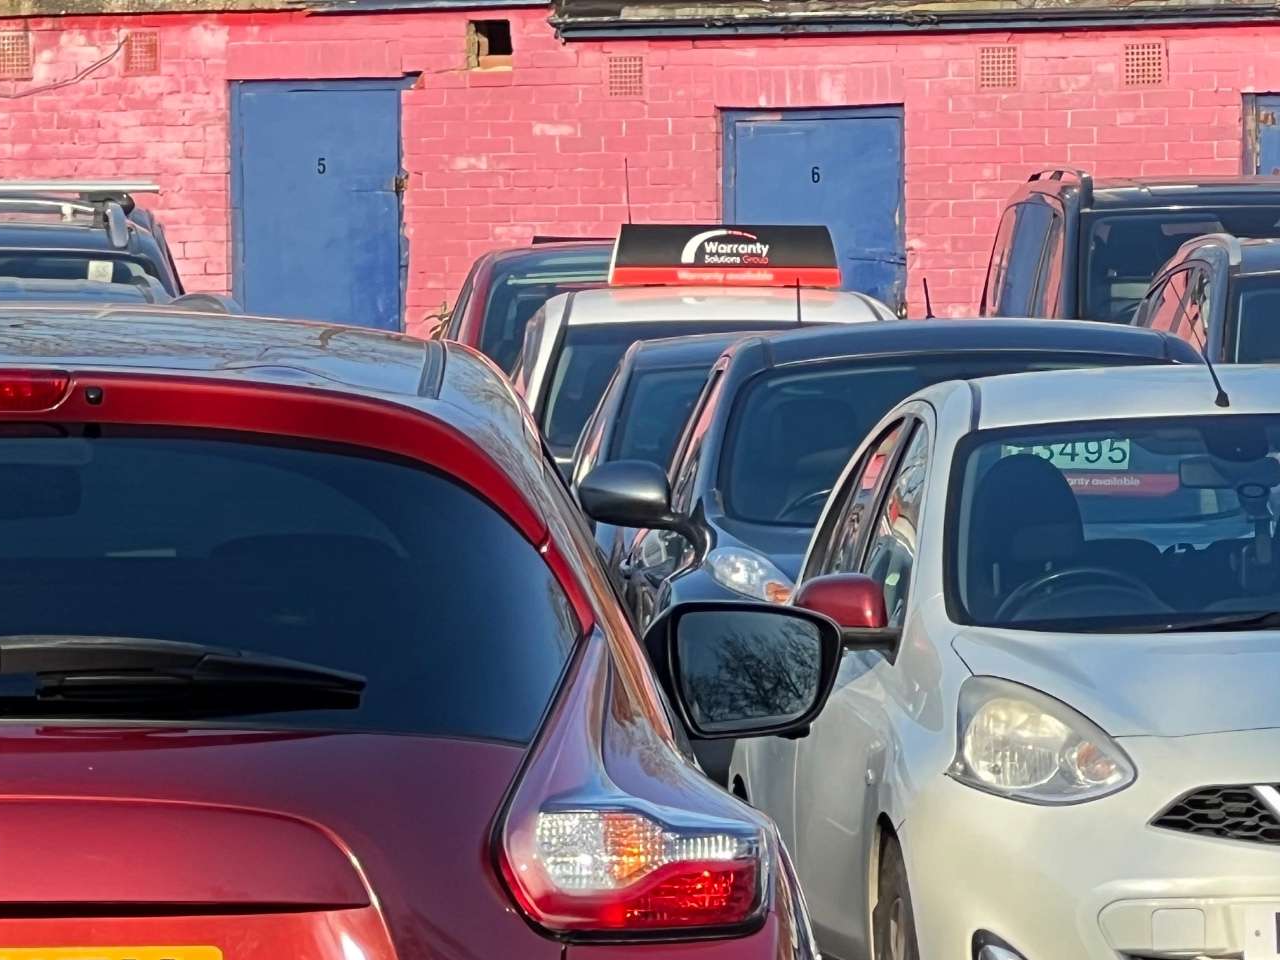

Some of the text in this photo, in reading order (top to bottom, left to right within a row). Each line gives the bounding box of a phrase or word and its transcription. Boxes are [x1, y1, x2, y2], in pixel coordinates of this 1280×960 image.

[317, 157, 326, 175] 5
[811, 166, 821, 184] 6
[704, 241, 770, 258] Warranty
[704, 255, 769, 265] Solutions Group
